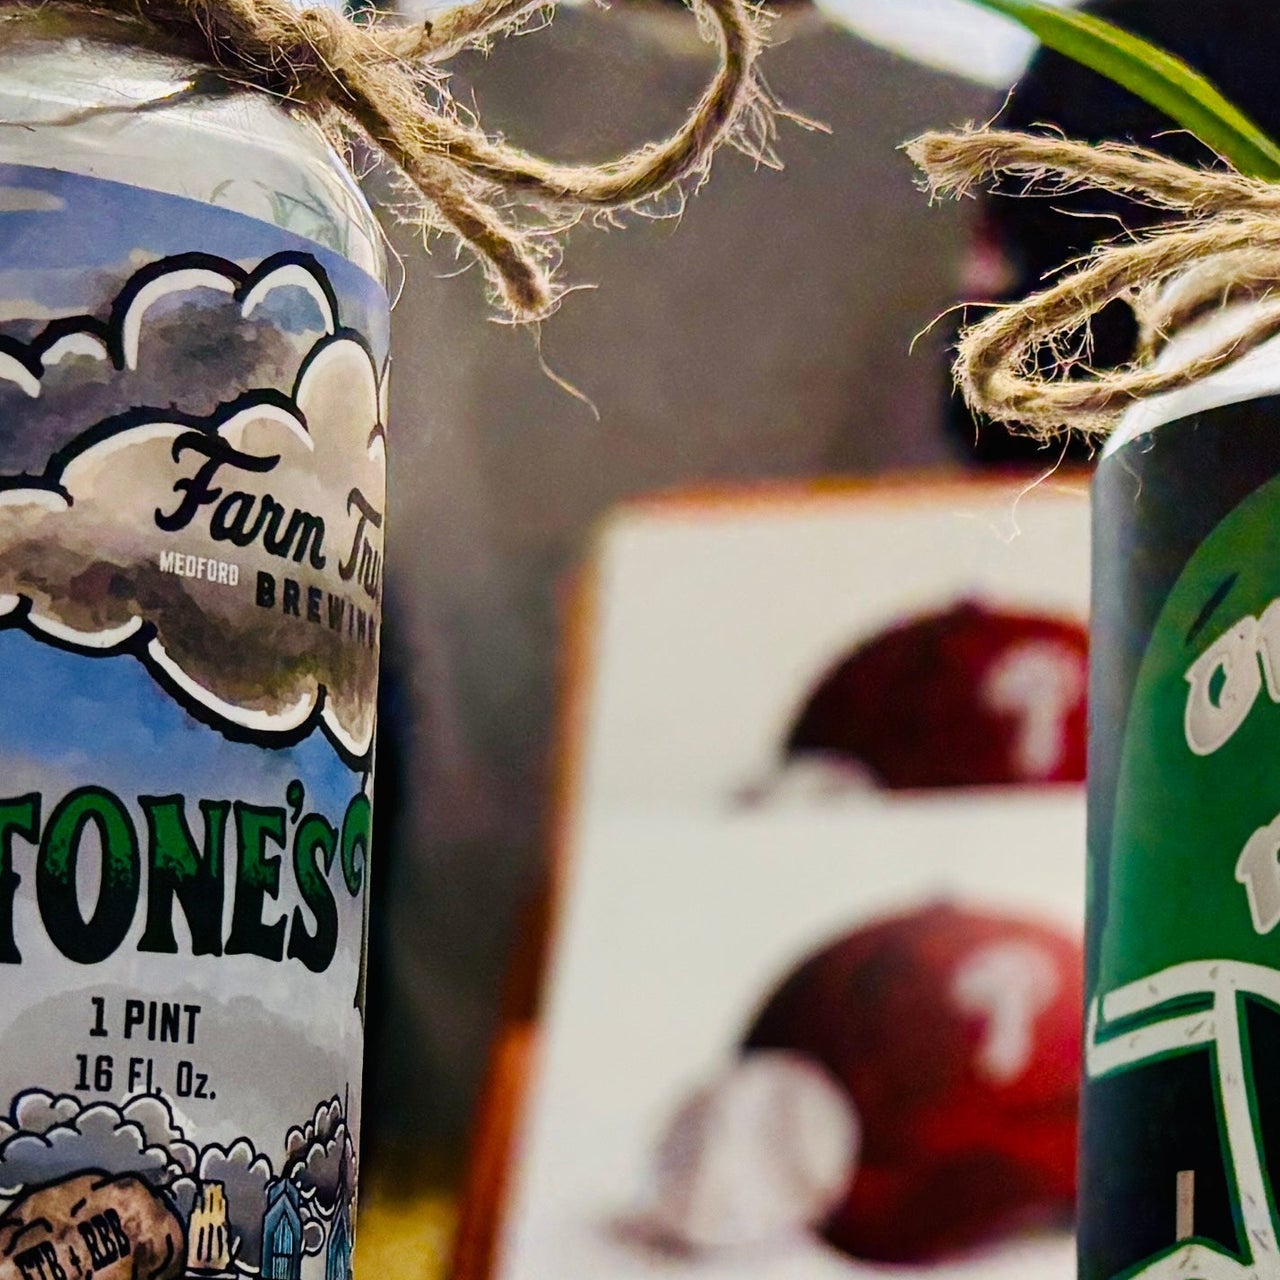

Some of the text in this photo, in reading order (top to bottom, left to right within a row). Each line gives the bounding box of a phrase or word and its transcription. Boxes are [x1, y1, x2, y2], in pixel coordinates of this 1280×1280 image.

[155, 431, 383, 600] Farm Tru
[159, 549, 239, 587] MEDFORD
[89, 997, 201, 1045] 1 PINT
[75, 1054, 113, 1093] 16
[77, 1208, 131, 1272] RBB
